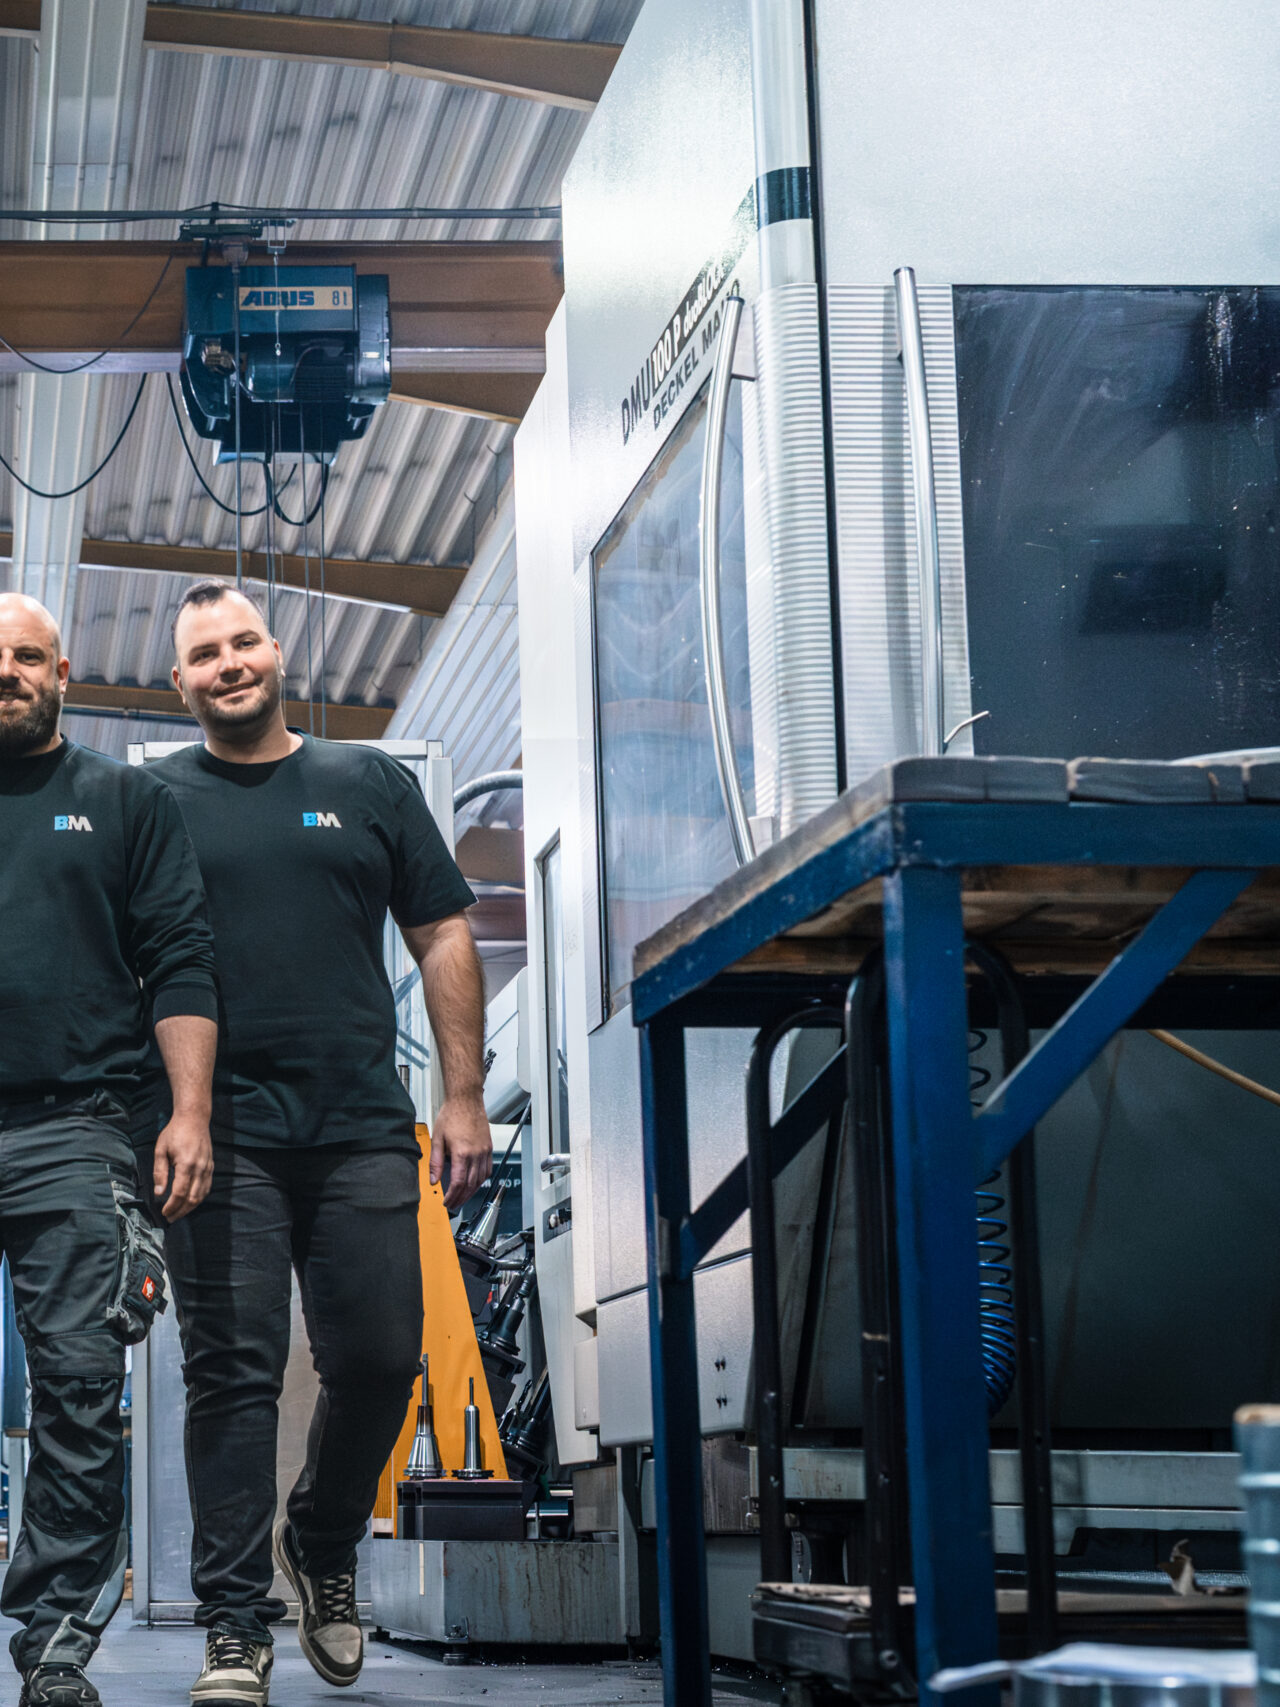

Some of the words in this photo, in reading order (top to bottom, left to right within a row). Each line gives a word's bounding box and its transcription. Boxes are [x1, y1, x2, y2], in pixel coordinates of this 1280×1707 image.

[241, 290, 314, 306] ABUS
[653, 346, 699, 431] DECKEL
[702, 278, 740, 355] MAO
[621, 357, 651, 446] DMU
[651, 328, 672, 388] 100
[54, 815, 93, 832] BM
[302, 811, 342, 828] BM
